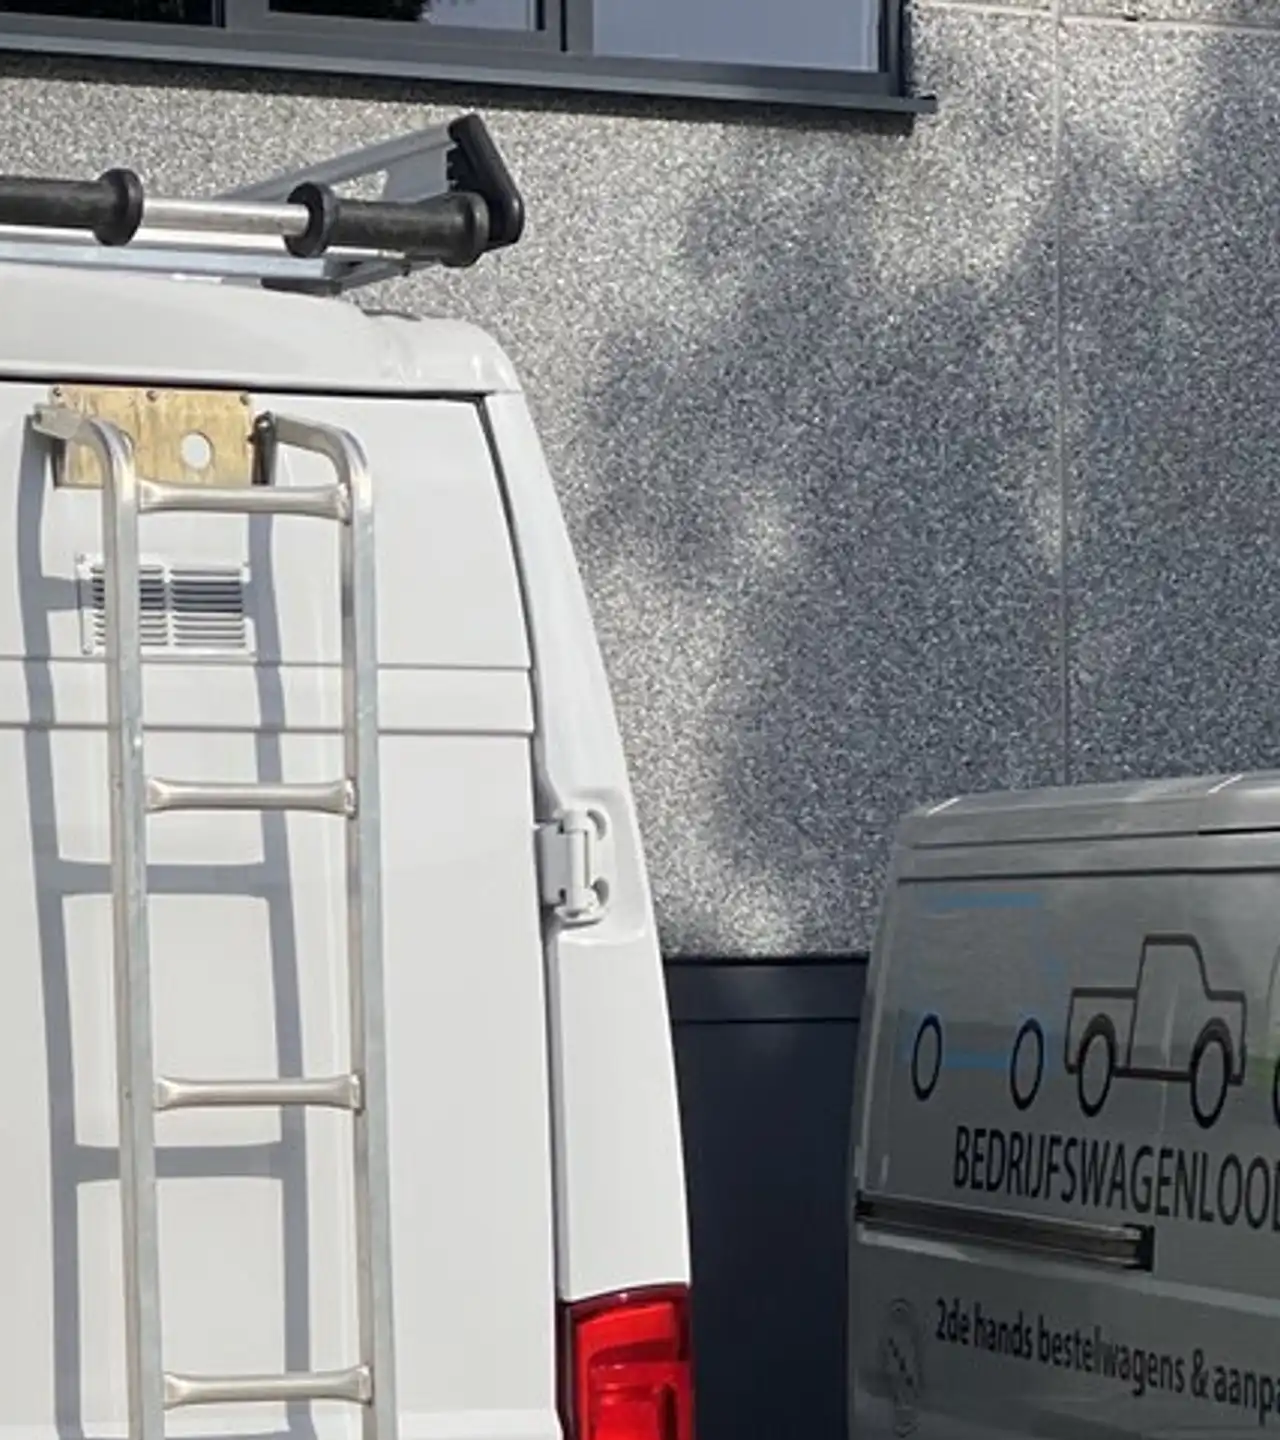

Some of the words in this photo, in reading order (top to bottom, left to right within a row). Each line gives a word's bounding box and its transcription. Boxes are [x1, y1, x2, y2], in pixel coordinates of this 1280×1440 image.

[936, 1297, 971, 1345] 2de
[973, 1302, 1033, 1362] hands
[1037, 1314, 1186, 1397] bestelwagens
[1191, 1348, 1210, 1399] &
[1213, 1364, 1280, 1428] aanp
